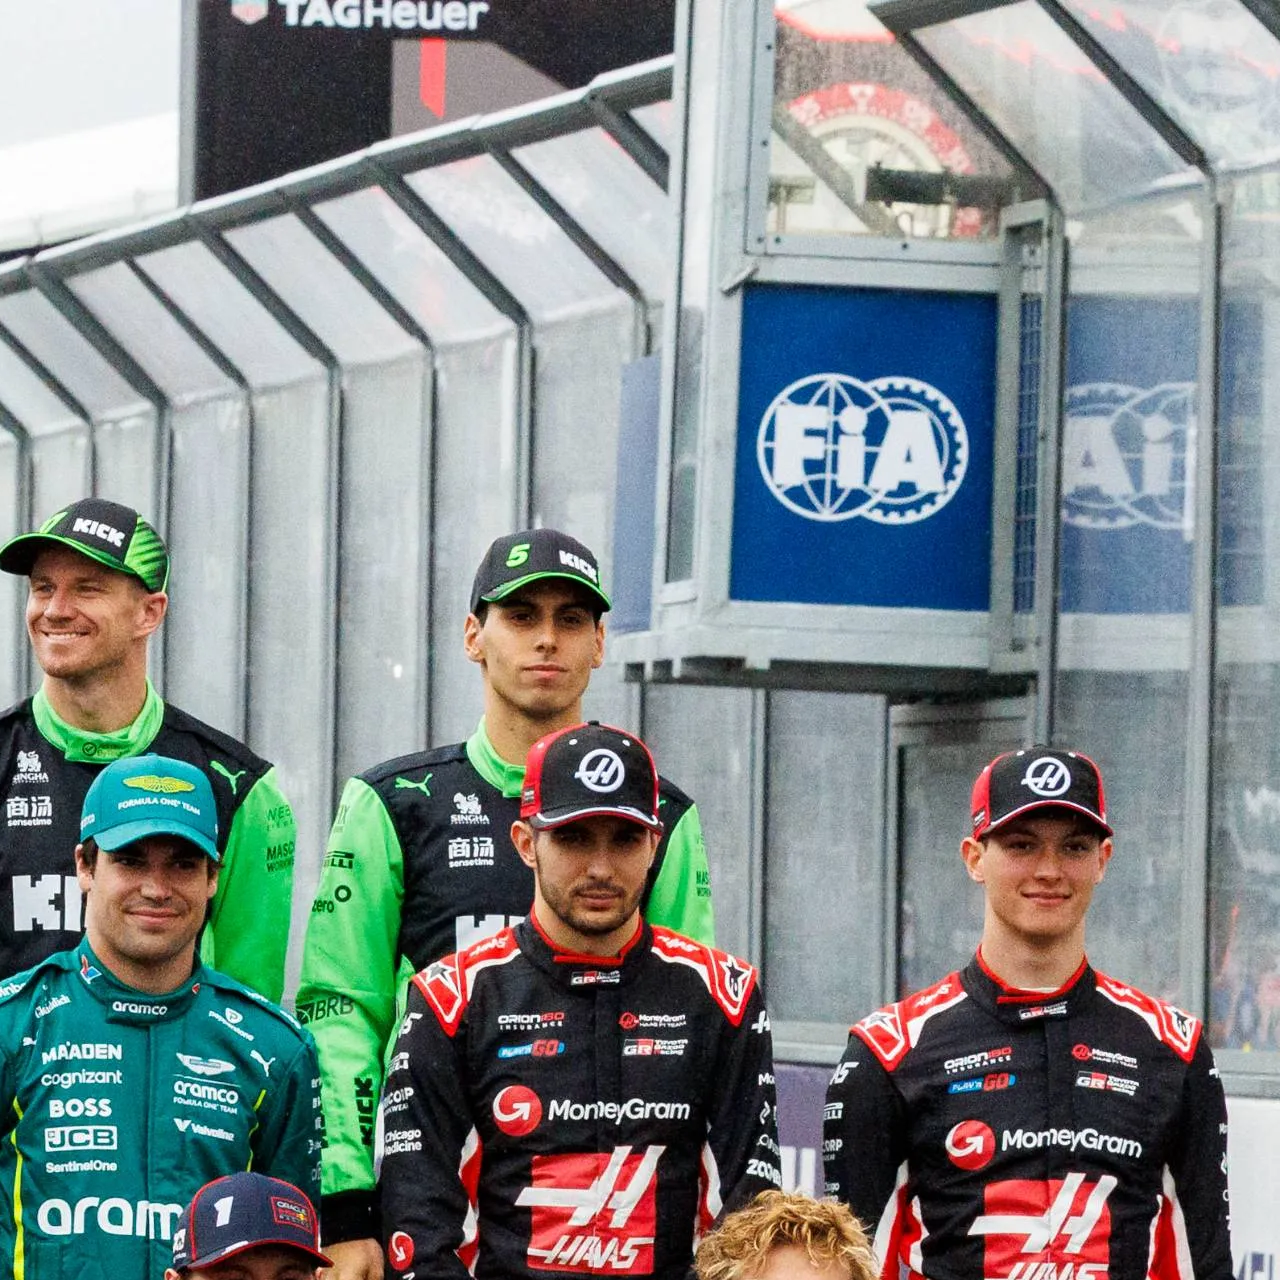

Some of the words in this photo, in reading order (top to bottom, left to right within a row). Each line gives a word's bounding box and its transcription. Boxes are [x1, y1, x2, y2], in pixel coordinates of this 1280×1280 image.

[72, 517, 125, 548] KICK
[505, 544, 531, 568] 5
[7, 795, 52, 818] 商汤
[118, 798, 158, 810] FORMULA
[182, 802, 200, 815] TEAM
[7, 817, 52, 827] sensetime
[450, 813, 490, 824] SINGHA
[448, 837, 494, 859] 商汤
[449, 857, 494, 868] sensetime
[112, 1001, 168, 1016] aramco
[314, 996, 354, 1021] BRB
[41, 1069, 123, 1090] cognizant
[173, 1080, 239, 1105] aramco
[49, 1099, 112, 1118] BOSS
[548, 1099, 690, 1125] MoneyGram
[49, 1128, 116, 1148] JCB
[1001, 1128, 1142, 1159] MoneyGram
[46, 1160, 118, 1174] SentinelOne
[213, 1196, 234, 1228] 1
[527, 1235, 654, 1269] HAAS
